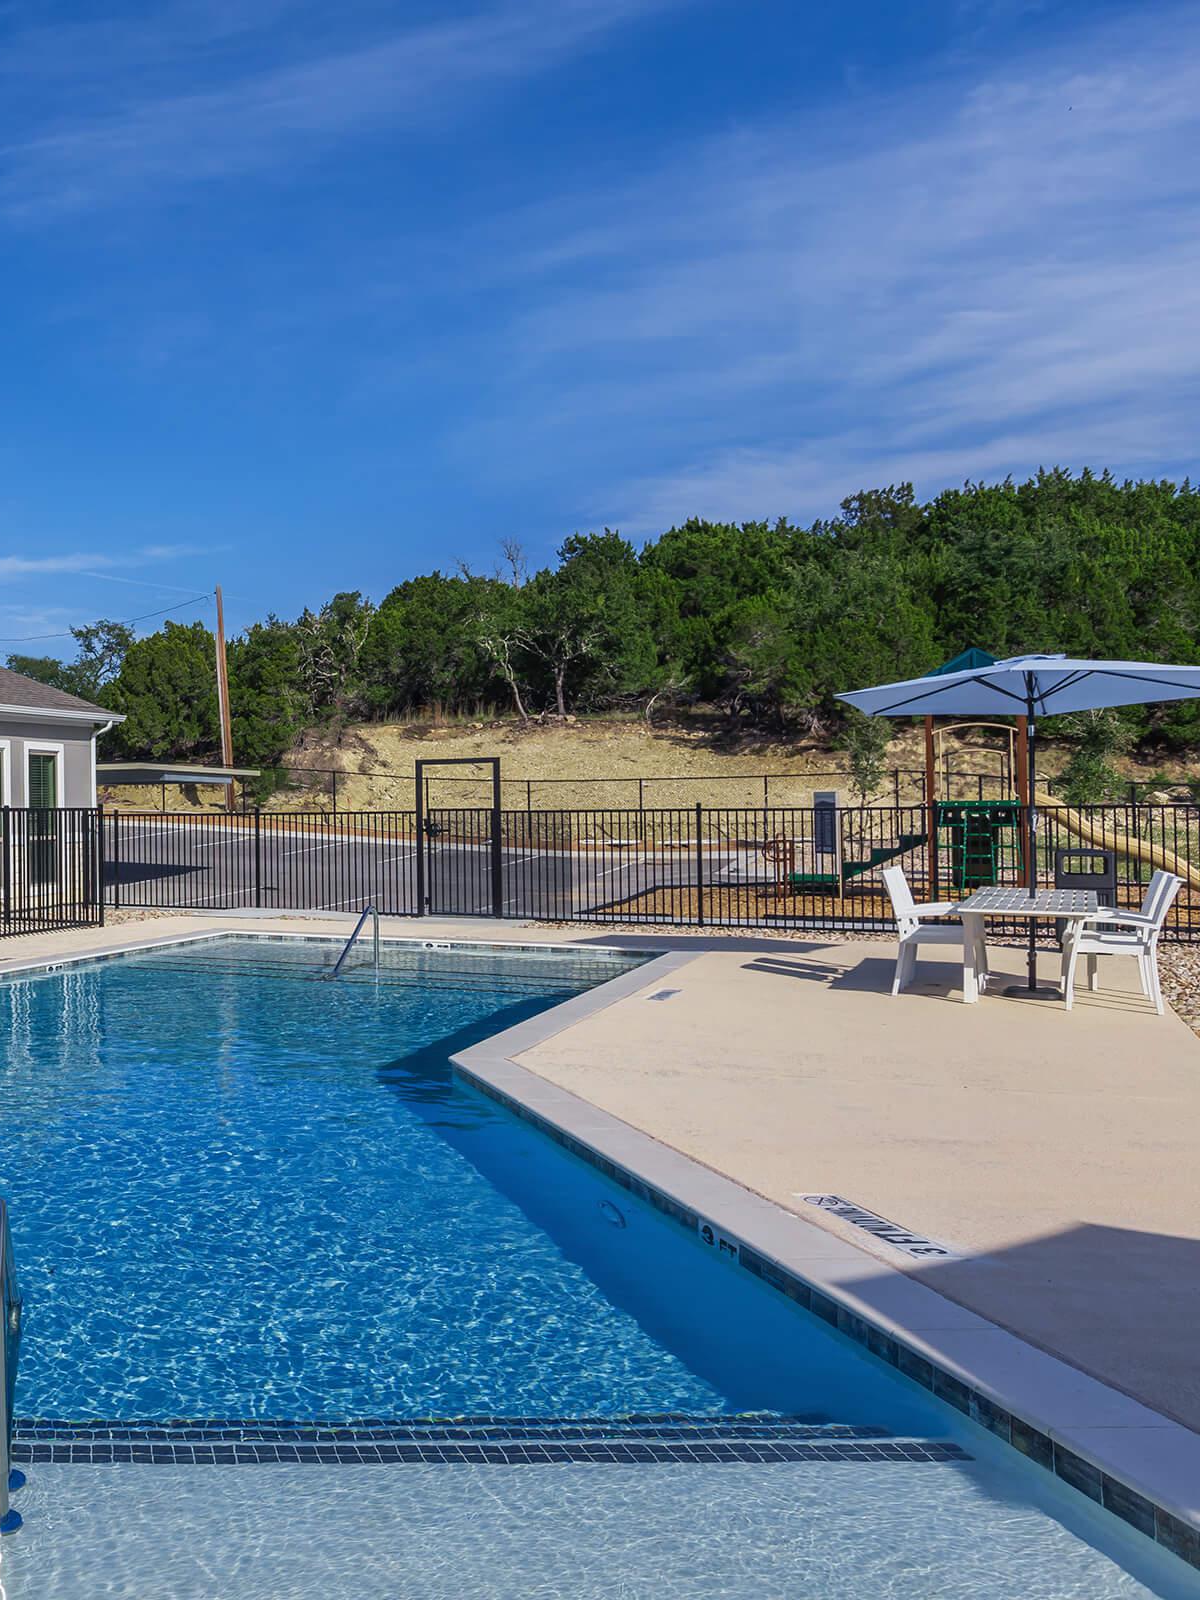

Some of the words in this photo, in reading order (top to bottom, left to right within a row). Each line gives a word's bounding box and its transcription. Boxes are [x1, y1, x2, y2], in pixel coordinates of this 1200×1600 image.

[702, 1225, 715, 1246] 3
[719, 1238, 737, 1258] FT
[872, 1232, 930, 1244] FT
